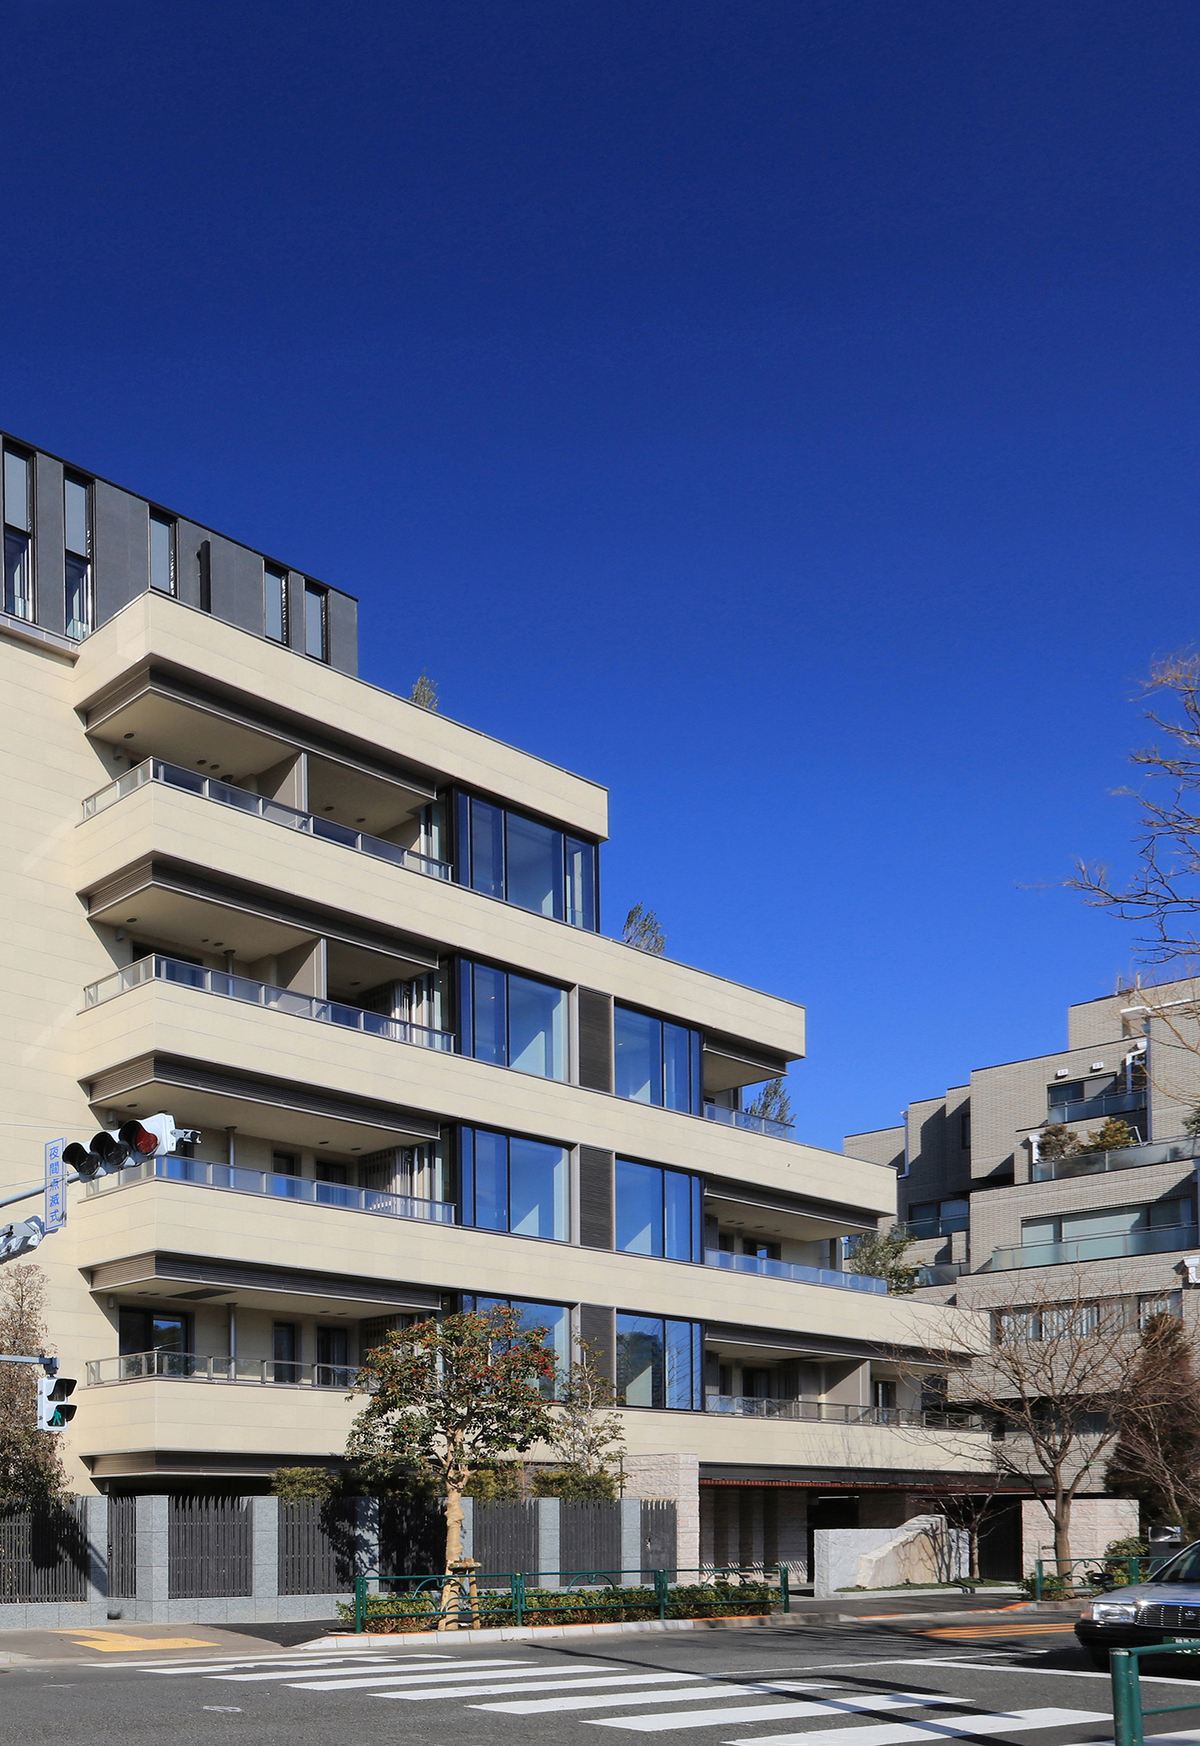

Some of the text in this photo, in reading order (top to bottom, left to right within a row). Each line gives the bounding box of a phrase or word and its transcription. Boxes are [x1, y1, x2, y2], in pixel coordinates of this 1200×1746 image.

[49, 1146, 60, 1223] 夜間点滅式
